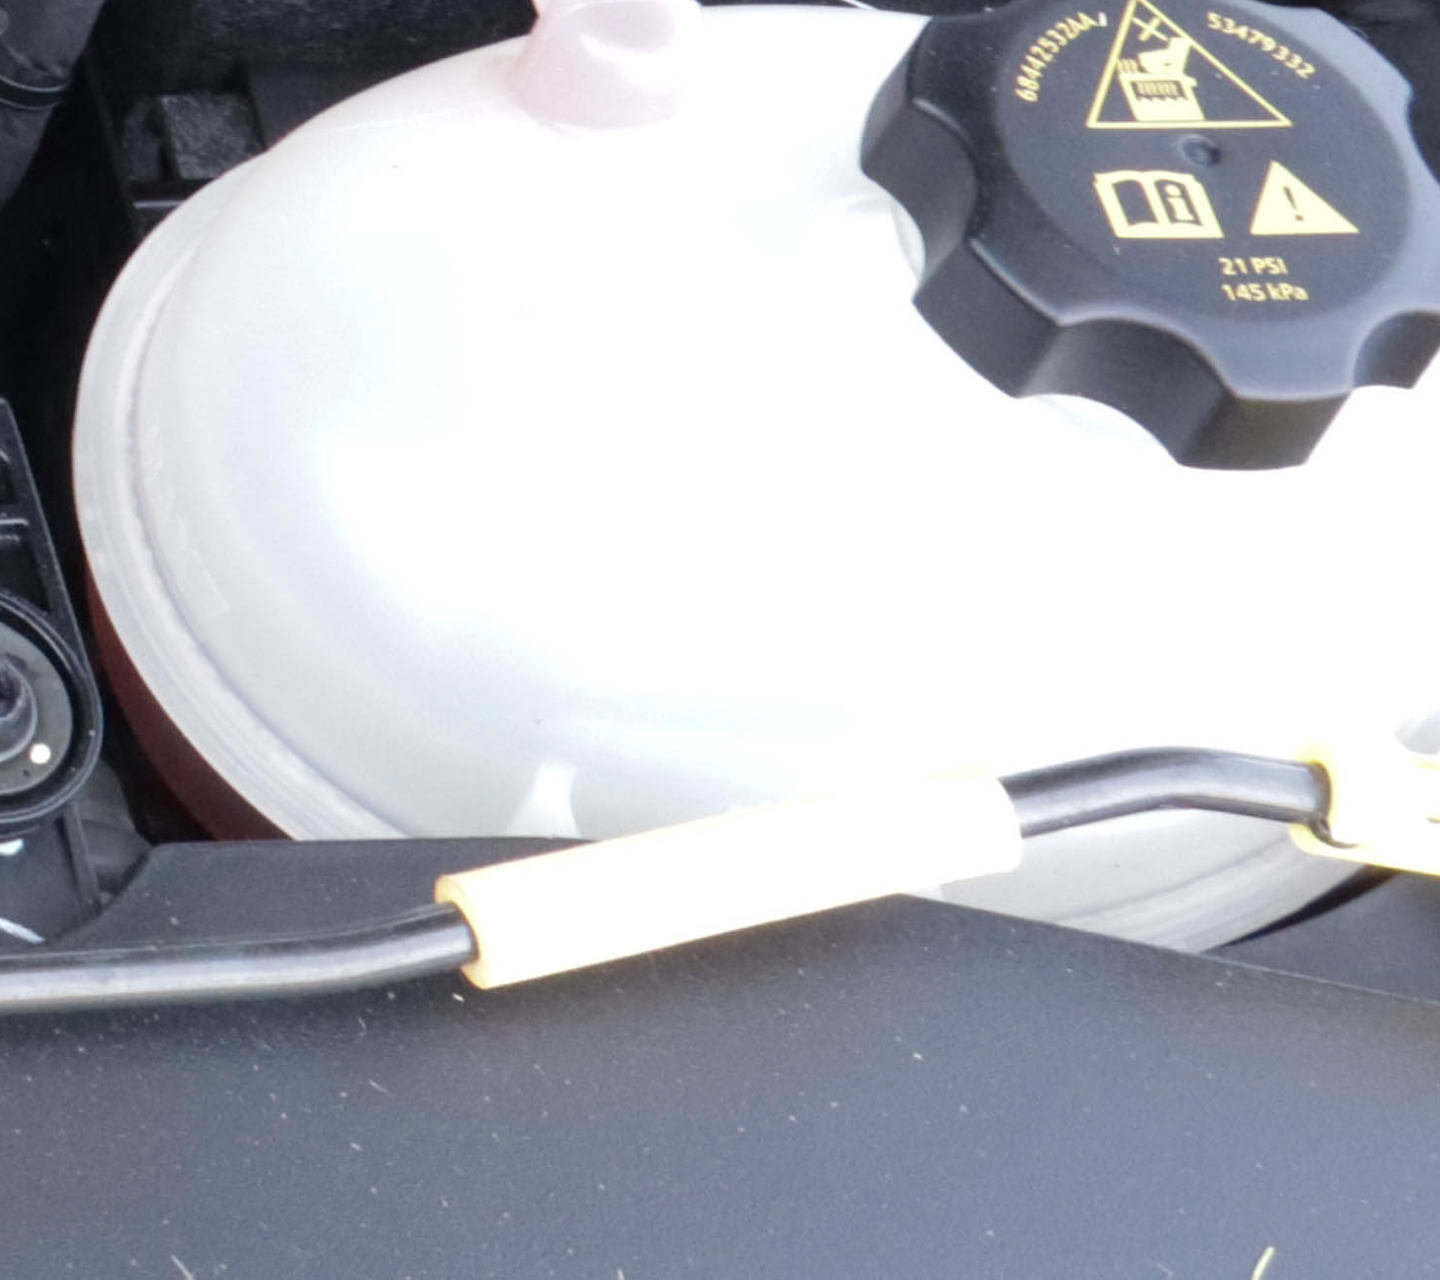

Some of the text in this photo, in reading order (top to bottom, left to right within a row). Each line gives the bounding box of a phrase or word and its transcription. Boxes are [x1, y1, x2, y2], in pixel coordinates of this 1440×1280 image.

[1218, 255, 1289, 276] 21 PSI
[1220, 281, 1310, 302] 145 kPa
